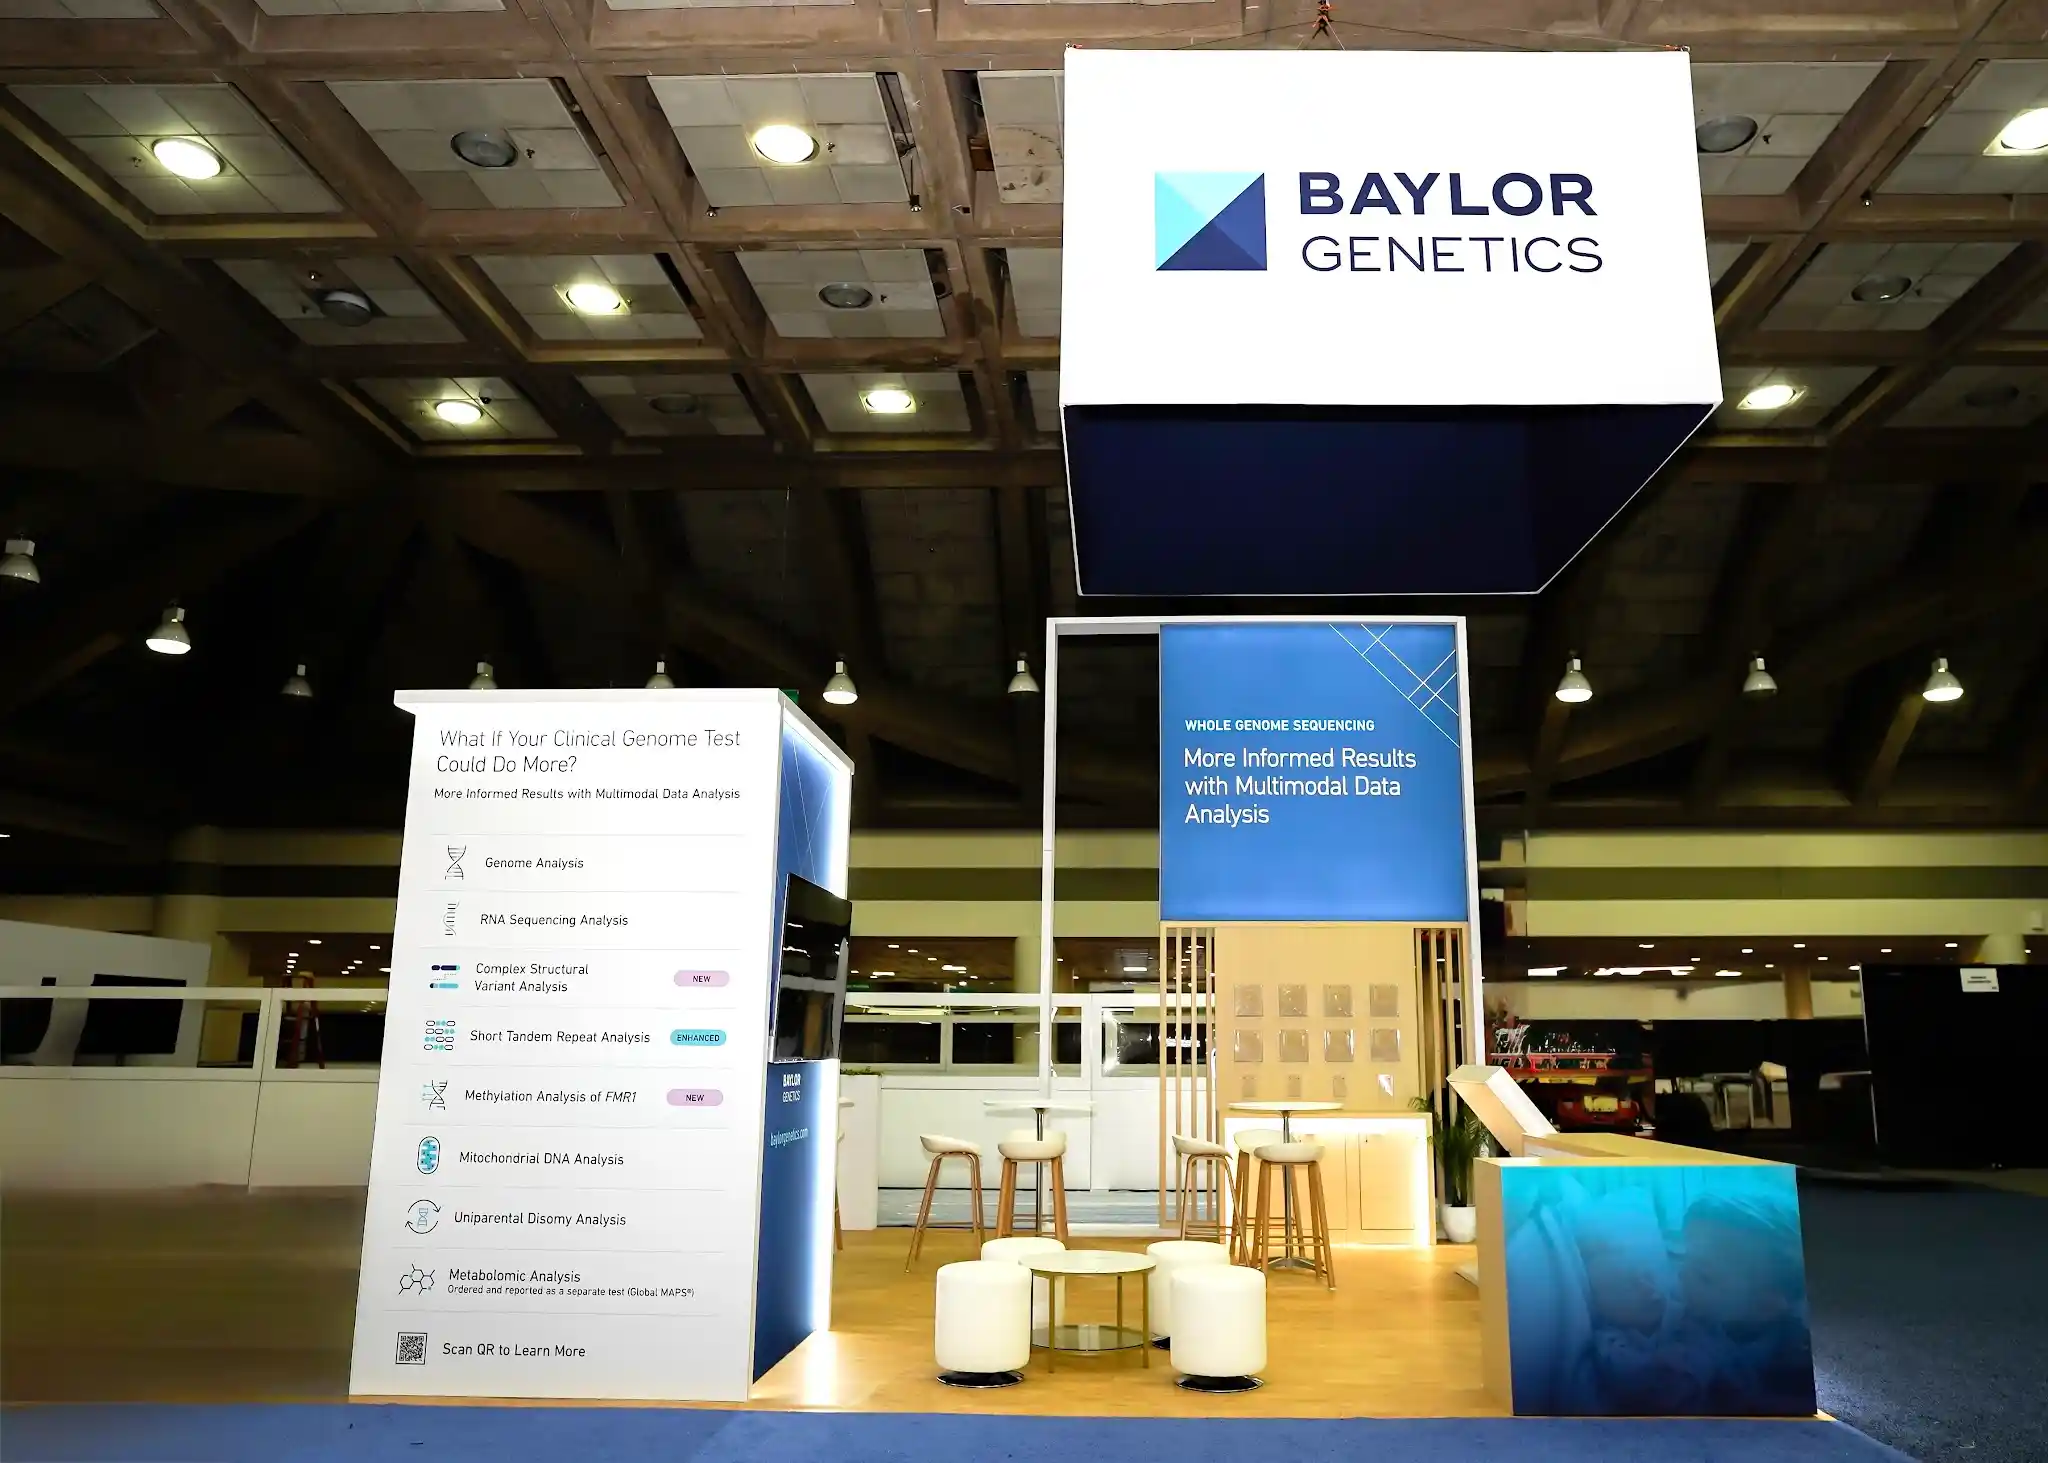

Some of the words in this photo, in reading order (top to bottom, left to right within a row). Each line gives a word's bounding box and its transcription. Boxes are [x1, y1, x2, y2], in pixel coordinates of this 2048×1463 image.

[1299, 172, 1597, 216] BAYLOR
[1302, 236, 1602, 273] GENETICS
[1185, 720, 1231, 731] WHOLE
[1235, 720, 1289, 731] GENOME
[1293, 720, 1375, 732] SEQUENCING
[440, 730, 485, 747] What
[492, 730, 503, 747] If
[509, 730, 545, 747] Your
[553, 730, 616, 747] Clinical
[622, 730, 698, 747] Genome
[705, 730, 741, 747] Test
[437, 756, 485, 773] Could
[493, 756, 516, 773] Do
[523, 756, 576, 773] More?
[1184, 748, 1235, 768] More
[1243, 748, 1334, 768] Informed
[1342, 748, 1417, 768] Results
[1185, 776, 1228, 796] with
[1236, 776, 1348, 796] Multimodal
[1355, 776, 1400, 796] Data
[434, 788, 462, 799] More
[466, 788, 518, 799] Informed
[522, 788, 563, 799] Results
[568, 788, 592, 799] with
[596, 788, 659, 799] Multimodal
[663, 788, 689, 799] Data
[693, 788, 740, 801] Analysis
[1185, 804, 1269, 828] Analysis
[485, 858, 532, 869] Genome
[536, 858, 584, 871] Analysis
[481, 914, 506, 925] RNA
[510, 914, 576, 927] Sequencing
[580, 914, 628, 927] Analysis
[476, 963, 526, 977] Complex
[530, 964, 588, 975] Structural
[693, 975, 711, 983] NEW
[474, 981, 516, 992] Variant
[519, 981, 568, 994] Analysis
[470, 1030, 503, 1042] Short
[506, 1031, 552, 1042] Tandem
[556, 1031, 598, 1045] Repeat
[601, 1031, 650, 1045] Analysis
[677, 1034, 720, 1042] ENHANCED
[783, 1073, 800, 1087] BAYLOR
[465, 1090, 533, 1104] Methylation
[537, 1090, 586, 1105] Analysis
[590, 1090, 601, 1103] of
[605, 1091, 636, 1103] FMR1
[686, 1094, 704, 1102] NEW
[782, 1090, 800, 1102] GENETICS
[459, 1152, 539, 1164] Mitochondrial
[544, 1153, 570, 1165] DNA
[574, 1153, 624, 1167] Analysis
[454, 1212, 523, 1227] Uniparental
[527, 1212, 572, 1227] Disomy
[576, 1212, 626, 1228] Analysis
[449, 1269, 526, 1283] Metabolomic
[530, 1270, 581, 1285] Analysis
[448, 1285, 483, 1294] Ordered
[486, 1286, 502, 1294] and
[505, 1286, 543, 1296] reported
[567, 1288, 605, 1297] separate
[608, 1288, 625, 1296] test
[627, 1288, 658, 1297] (Global
[443, 1343, 472, 1355] Scan
[477, 1344, 494, 1356] QR
[499, 1344, 510, 1356] to
[515, 1344, 550, 1356] Learn
[555, 1345, 585, 1357] More
